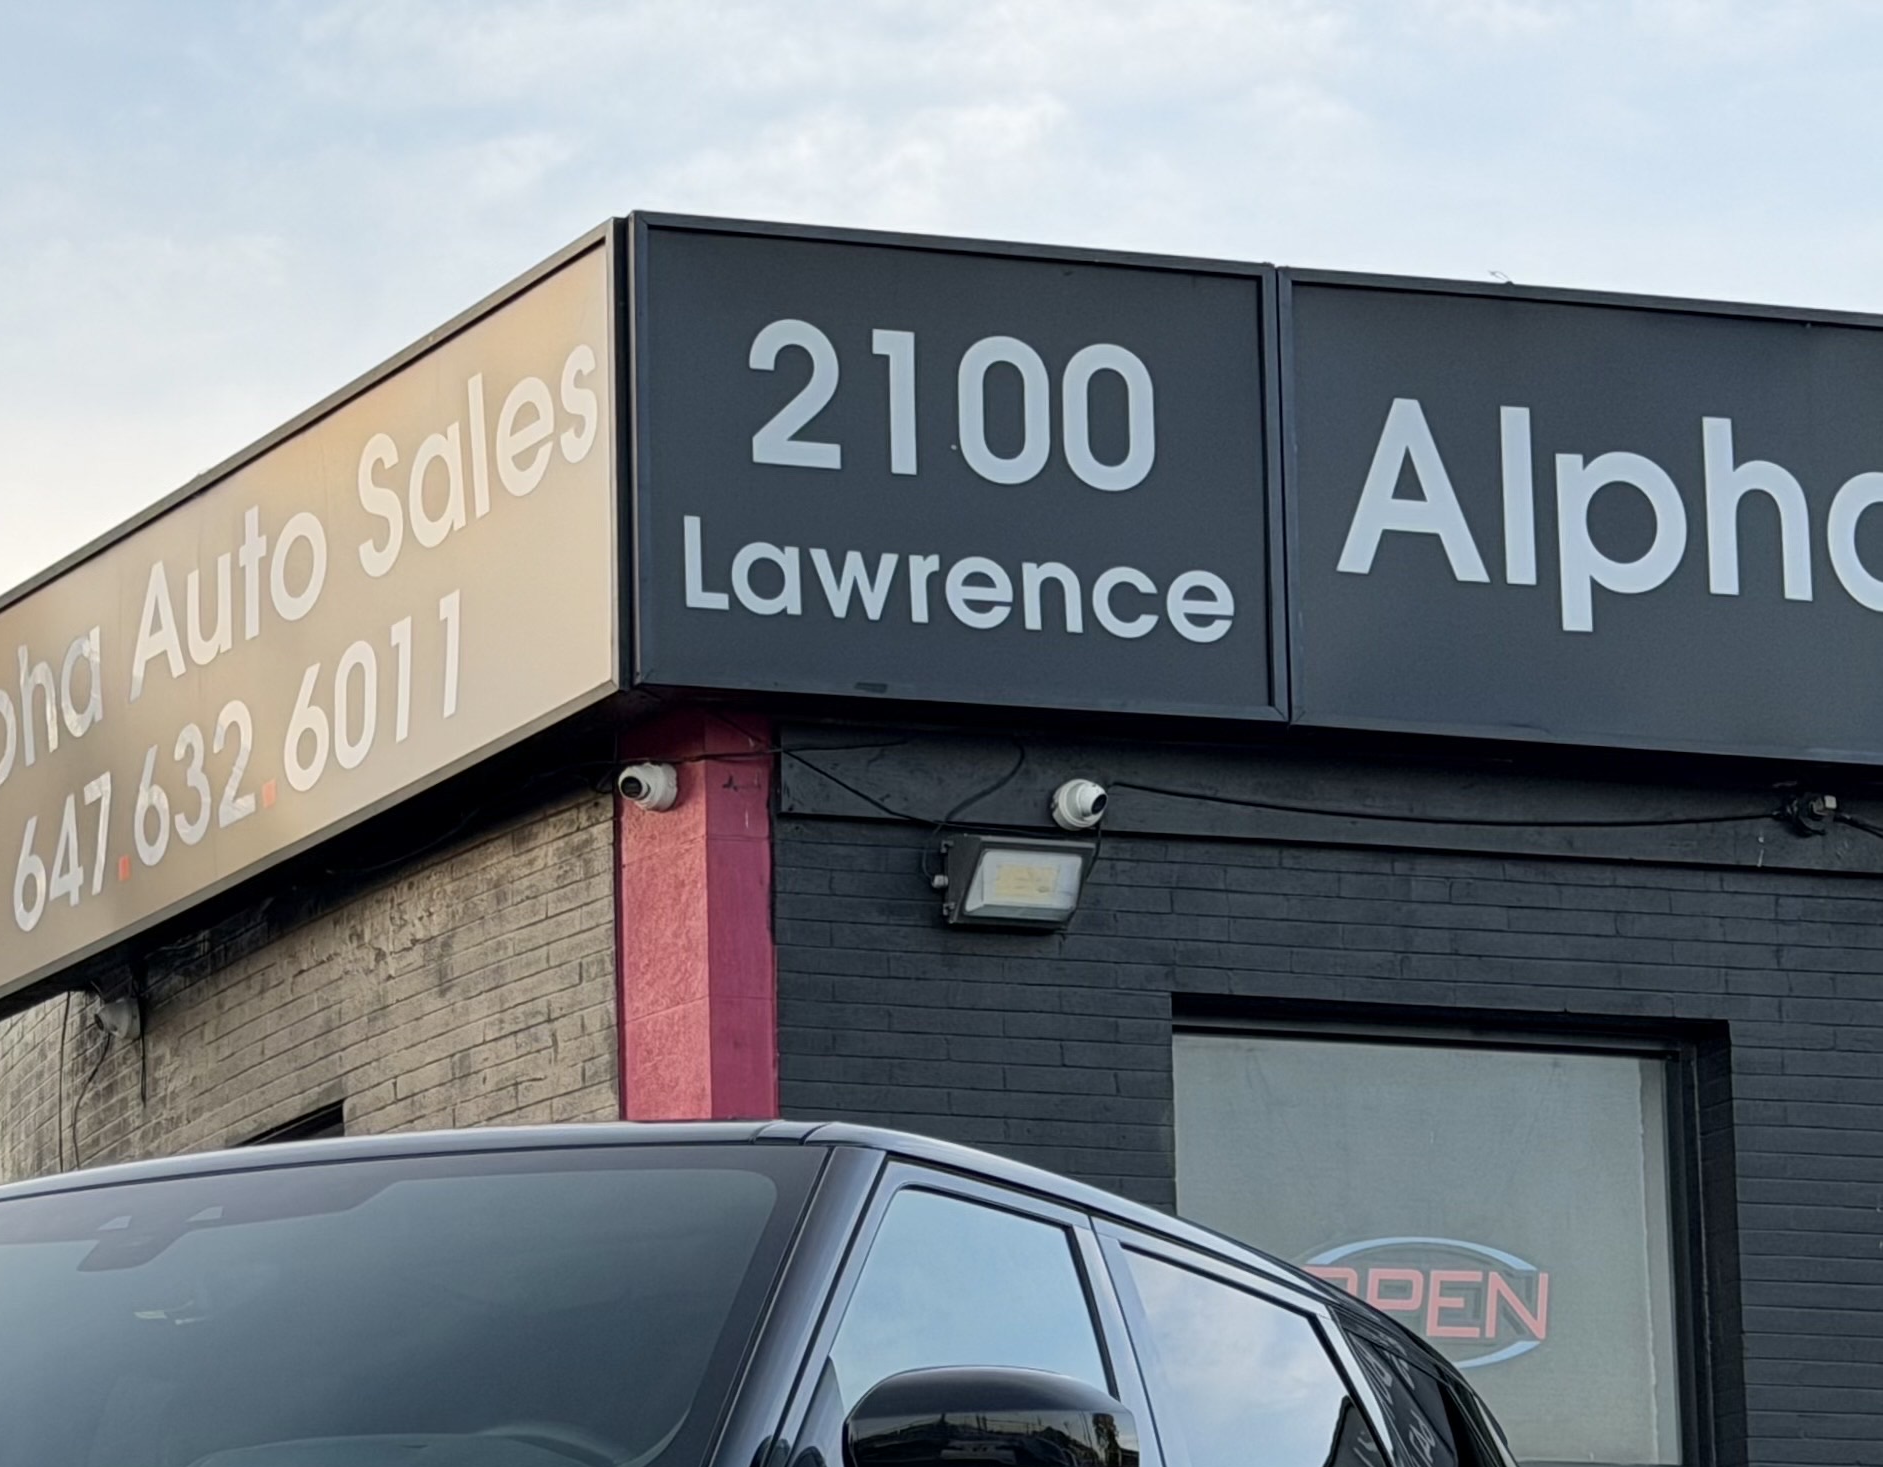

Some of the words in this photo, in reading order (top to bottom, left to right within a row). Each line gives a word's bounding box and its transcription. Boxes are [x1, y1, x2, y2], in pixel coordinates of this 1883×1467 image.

[748, 318, 1156, 491] 2100
[129, 505, 327, 703] Auto
[357, 344, 598, 578] Sales
[682, 514, 1236, 644] Lawrence
